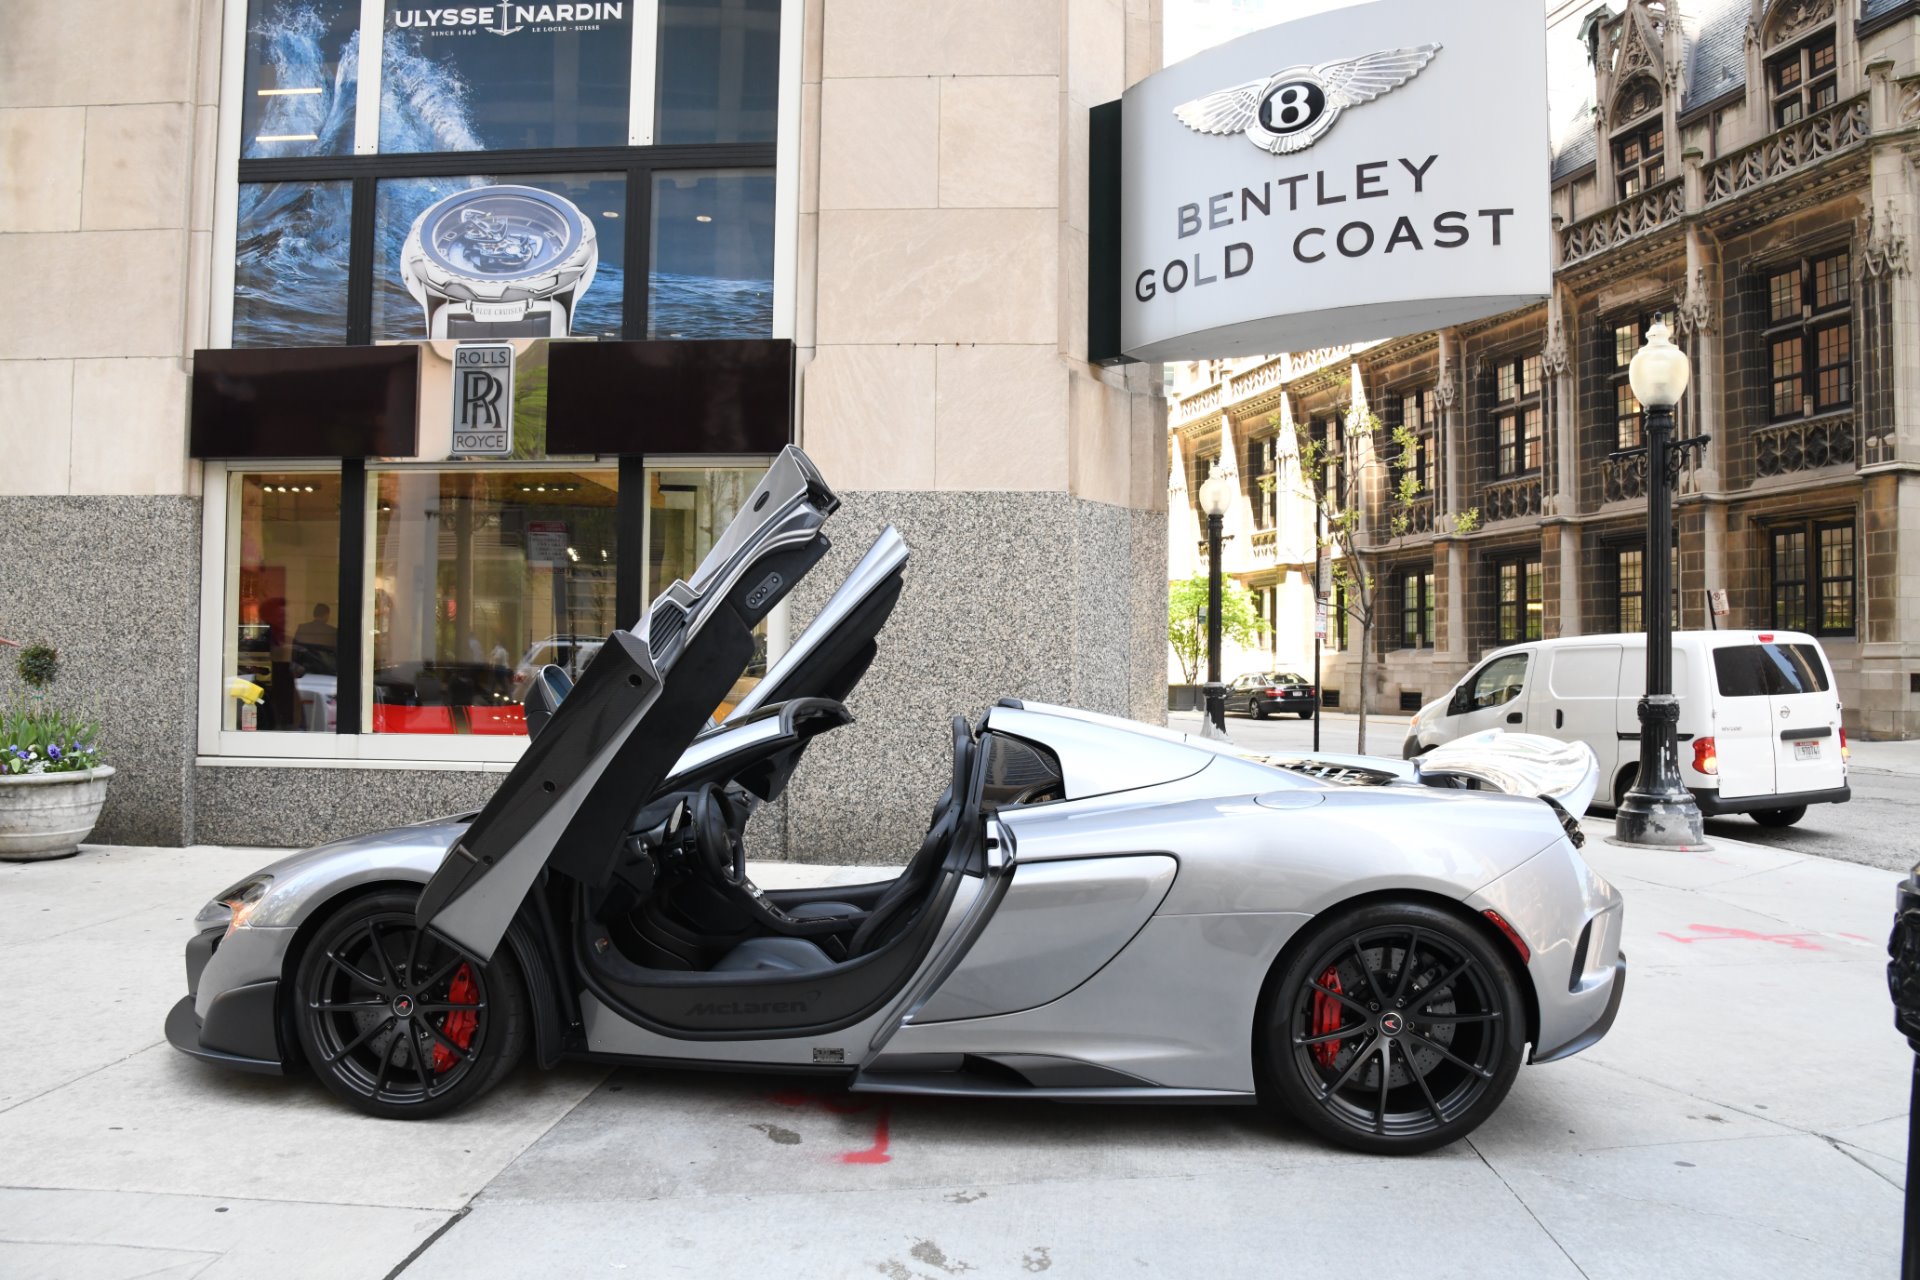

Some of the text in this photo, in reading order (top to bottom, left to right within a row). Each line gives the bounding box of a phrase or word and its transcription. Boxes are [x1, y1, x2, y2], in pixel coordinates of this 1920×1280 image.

[395, 2, 623, 27] ULYSSE NARDIN
[1178, 154, 1439, 240] BENTLEY
[1135, 208, 1514, 302] GOLD COAST
[475, 306, 523, 315] BLUE CRUISER
[459, 351, 506, 364] ROLLS
[456, 435, 504, 448] ROYCE
[684, 1000, 807, 1017] McLaren
